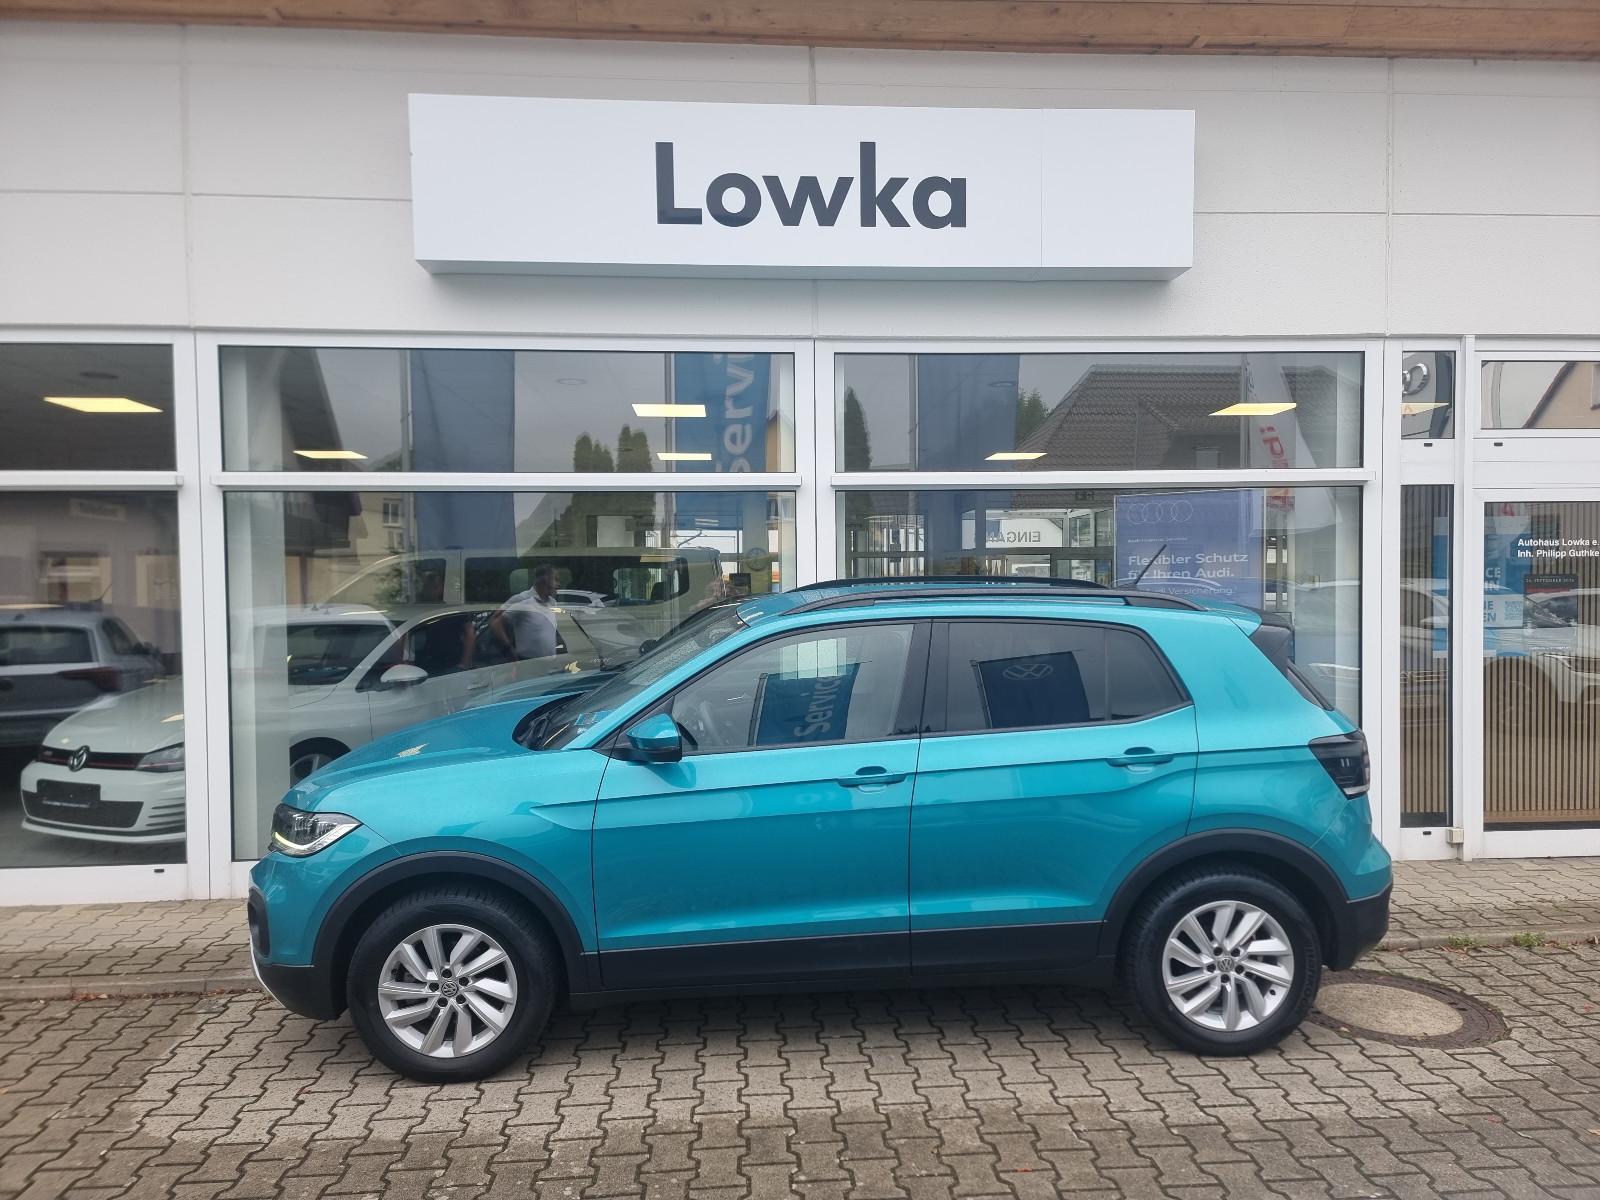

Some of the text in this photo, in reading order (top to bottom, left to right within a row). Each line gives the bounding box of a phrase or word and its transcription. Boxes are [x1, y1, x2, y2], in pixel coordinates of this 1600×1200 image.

[655, 141, 967, 229] Lowka
[1517, 538, 1560, 547] Autohaus
[1562, 538, 1590, 546] Lowka
[1128, 553, 1248, 565] Flexibler Schutz
[1517, 549, 1600, 559] Inh. Philipp Guthke
[1127, 567, 1235, 579] fü Ihren Audi.
